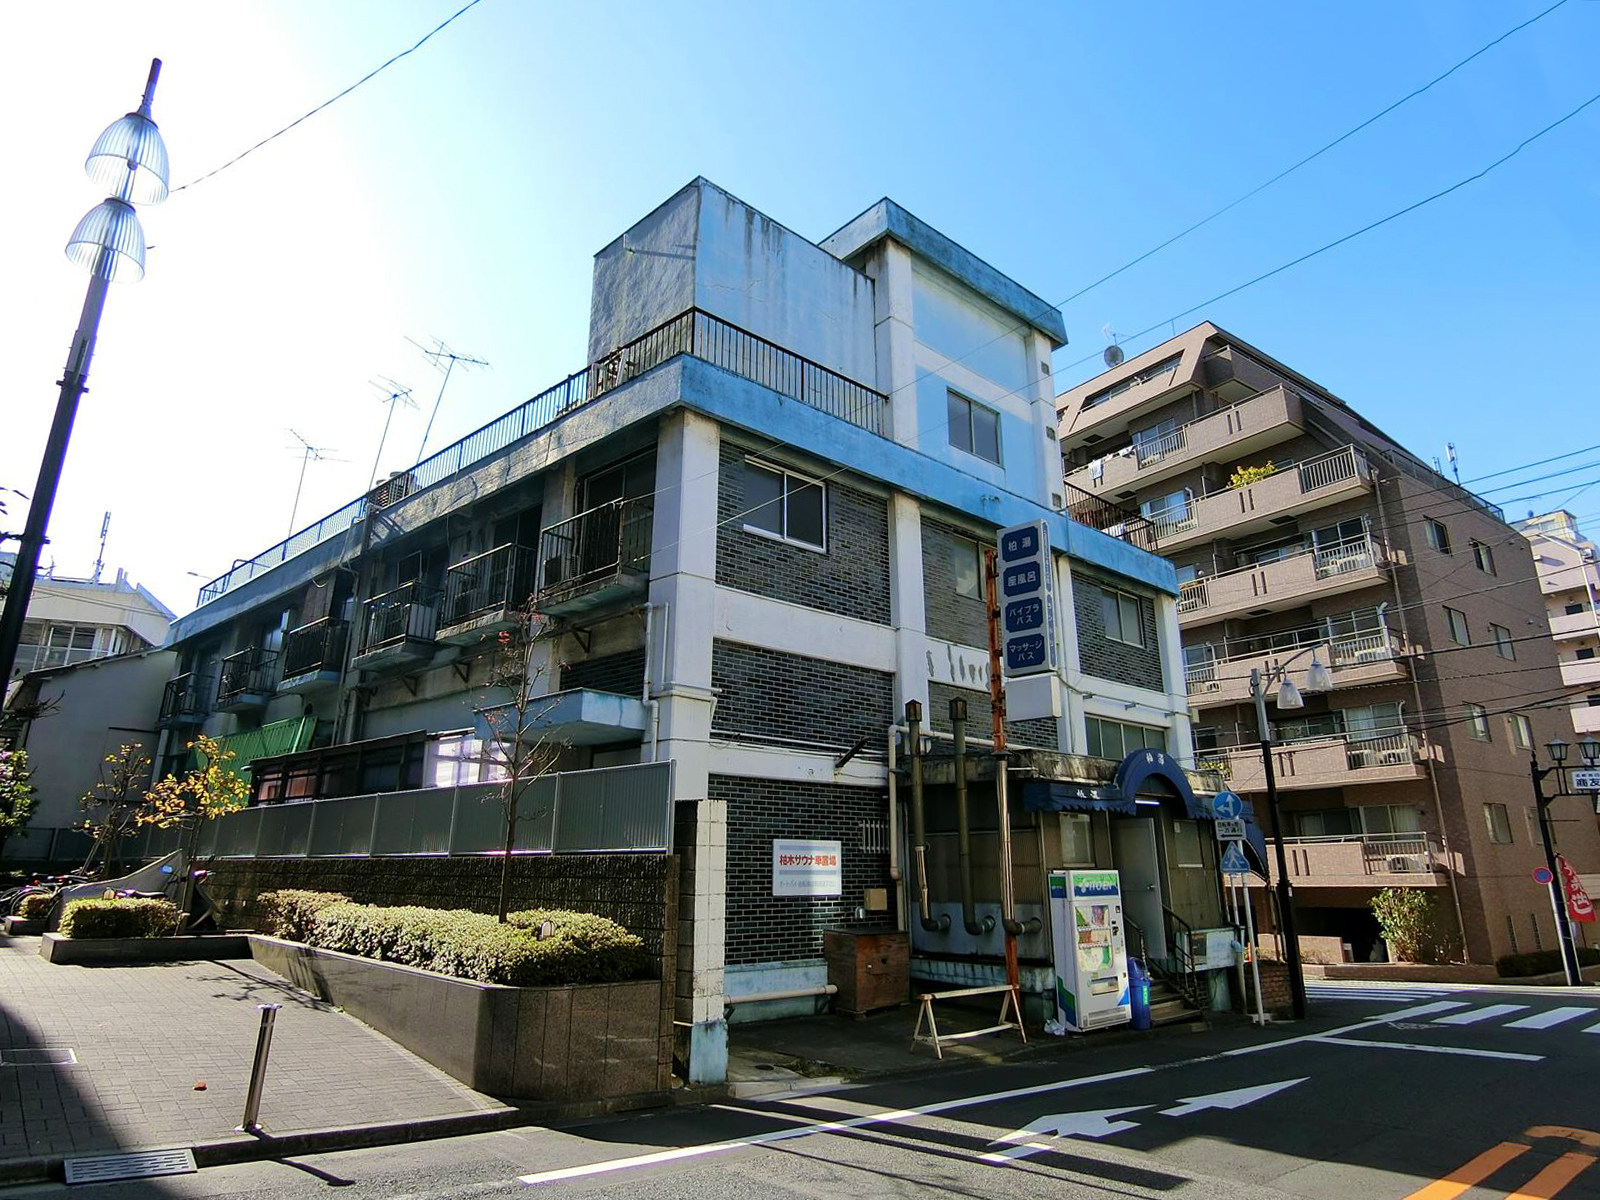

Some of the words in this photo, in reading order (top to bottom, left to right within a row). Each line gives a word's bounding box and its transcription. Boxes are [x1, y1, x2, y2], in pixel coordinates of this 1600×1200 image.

[1009, 640, 1042, 653] マッサージ
